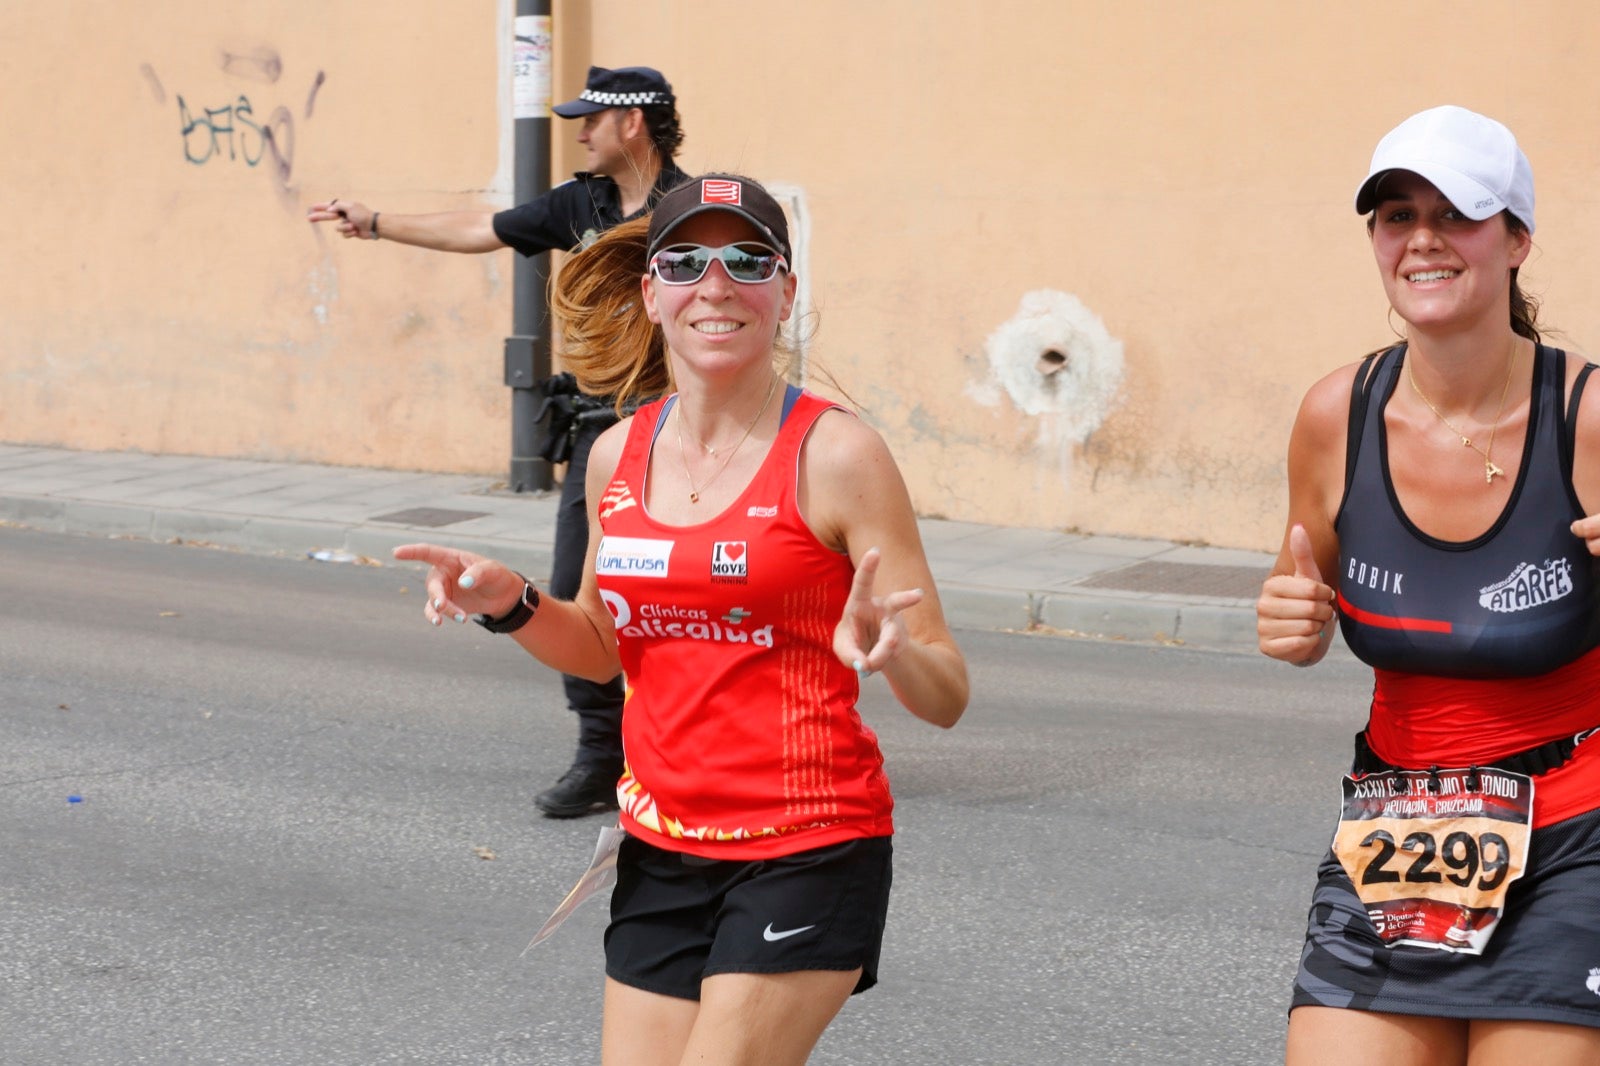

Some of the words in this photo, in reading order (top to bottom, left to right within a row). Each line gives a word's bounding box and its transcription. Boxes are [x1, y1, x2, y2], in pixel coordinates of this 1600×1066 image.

[715, 544, 722, 562] I
[712, 563, 746, 574] MOVE
[1348, 557, 1404, 595] GOBIK
[1490, 562, 1569, 610] ATARFE
[639, 603, 708, 621] Clínicas
[1359, 829, 1511, 891] 2299
